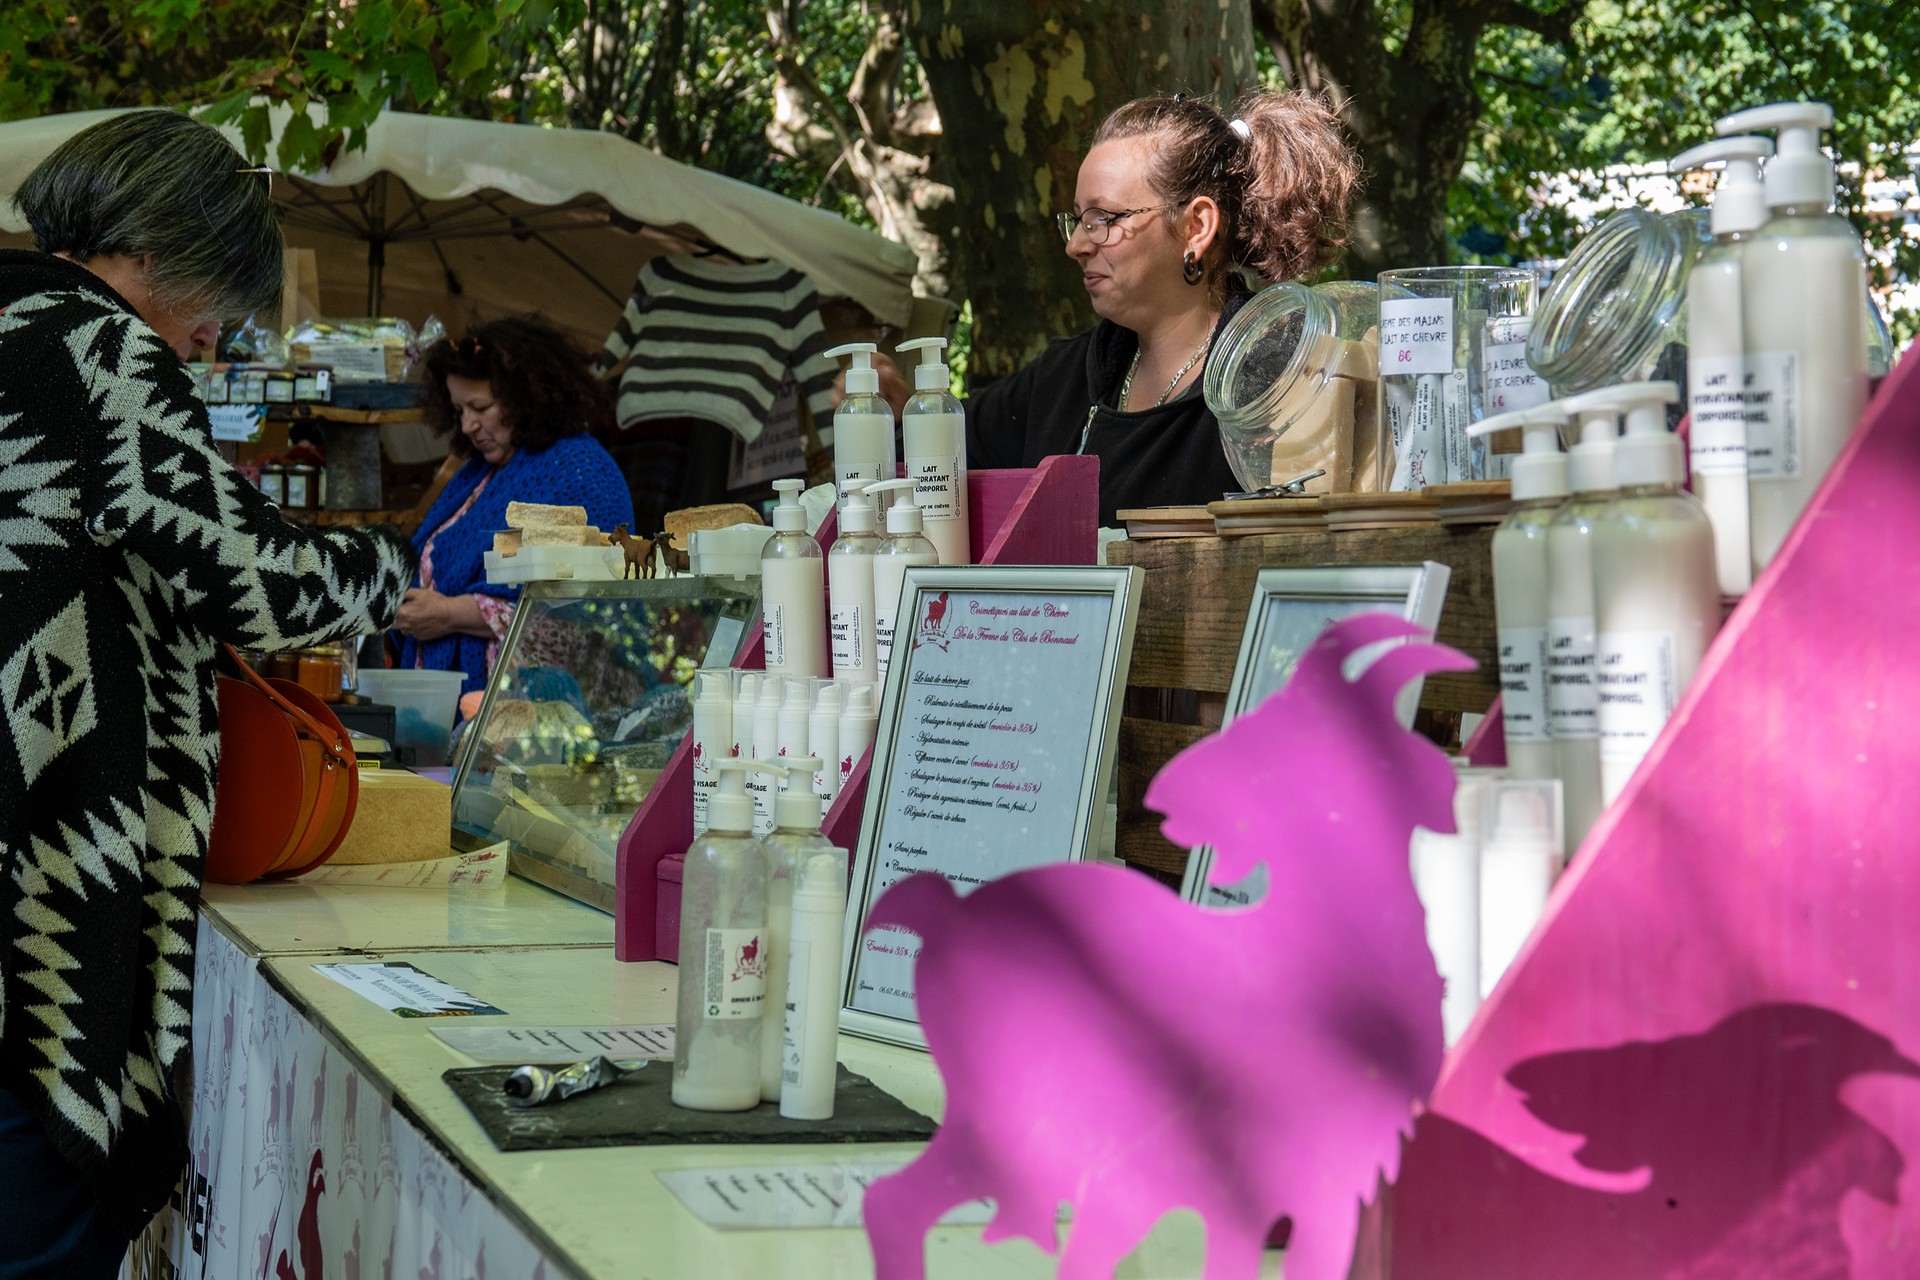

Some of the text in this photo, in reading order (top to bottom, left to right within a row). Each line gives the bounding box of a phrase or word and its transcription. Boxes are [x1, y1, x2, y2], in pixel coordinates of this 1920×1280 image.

[1398, 316, 1411, 327] DES
[1414, 315, 1445, 327] MAINS
[1384, 331, 1449, 345] LAIT DE CHEVRE
[1504, 374, 1537, 387] CHEVRE
[1009, 606, 1019, 617] au
[1019, 602, 1031, 617] lait
[1032, 604, 1041, 617] de
[952, 625, 968, 640] De
[967, 627, 974, 640] la
[974, 626, 1000, 641] Ferme
[999, 630, 1009, 642] du
[1012, 627, 1028, 643] Clos
[1028, 630, 1038, 643] de
[1039, 629, 1080, 645] Bonnaud
[914, 669, 925, 683] Le
[697, 780, 718, 788] VISAGE
